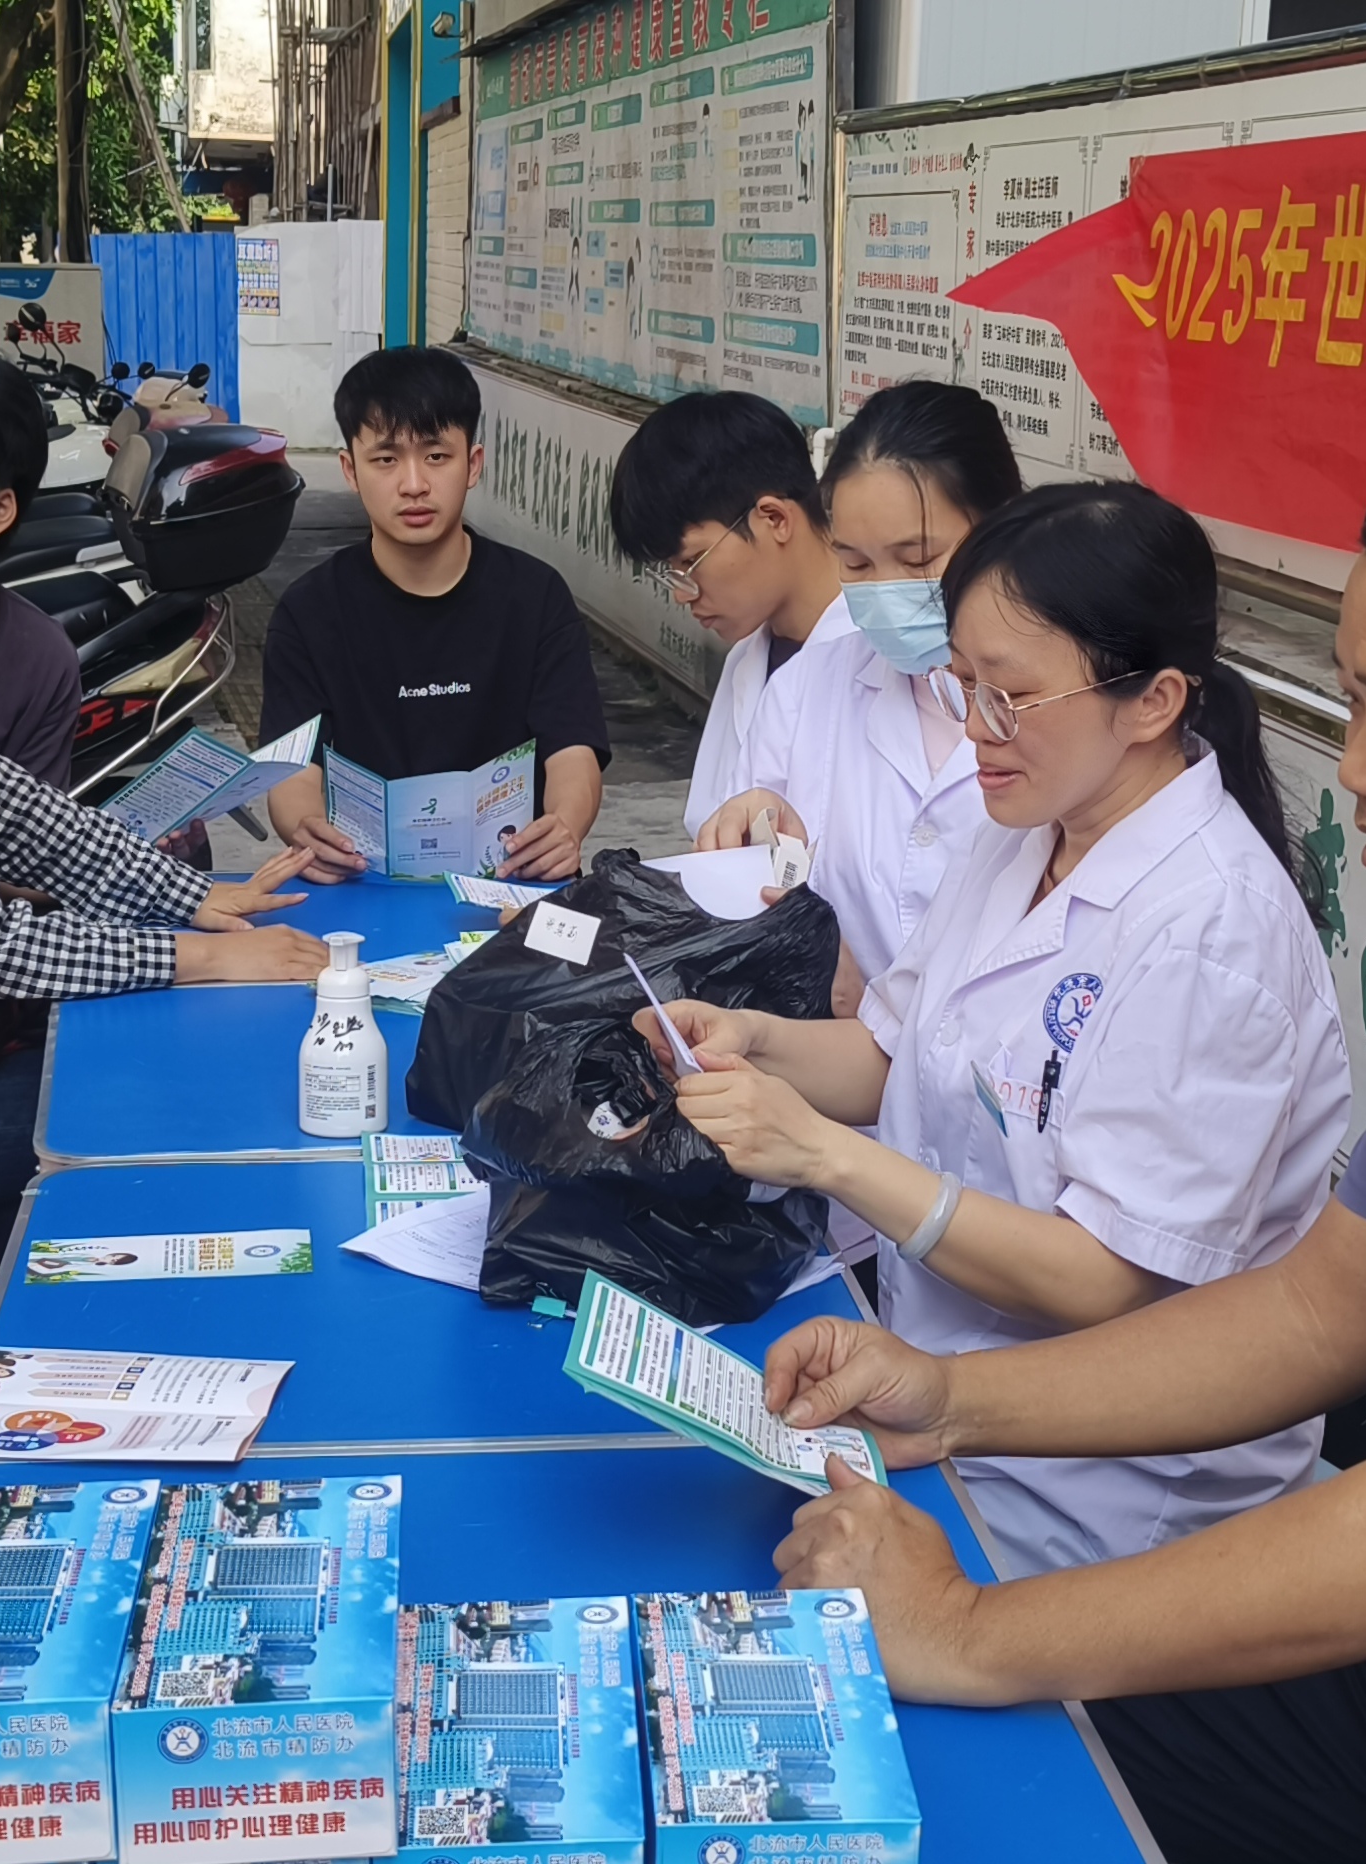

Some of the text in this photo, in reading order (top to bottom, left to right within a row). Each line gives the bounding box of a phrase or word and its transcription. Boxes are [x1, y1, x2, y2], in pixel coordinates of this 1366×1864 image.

[398, 682, 471, 698] Acne Studios
[212, 1713, 354, 1738] 北流市人民医院
[214, 1737, 355, 1760] 北流市精防办
[171, 1777, 384, 1811] 用心关注精神疾病
[133, 1812, 346, 1846] 用心呵护心理健康
[748, 1833, 884, 1852] 北流市人民医院
